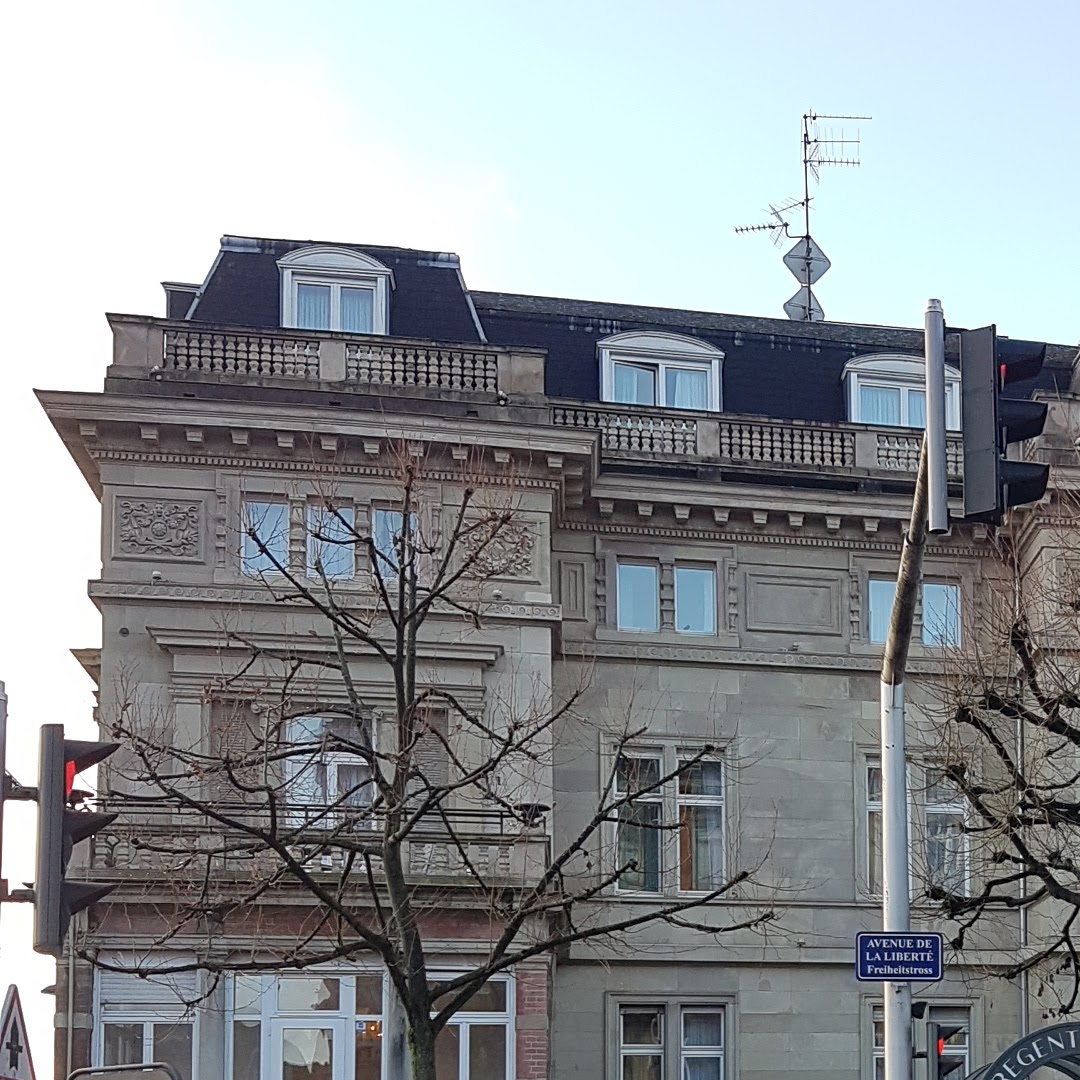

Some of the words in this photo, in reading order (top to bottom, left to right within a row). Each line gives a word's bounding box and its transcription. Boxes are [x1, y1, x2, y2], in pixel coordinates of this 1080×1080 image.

[867, 938, 914, 949] AVENUE
[917, 939, 933, 949] DE
[866, 952, 881, 961] LA
[884, 949, 934, 962] LIBERTÉ
[867, 964, 933, 975] Freiheitstross
